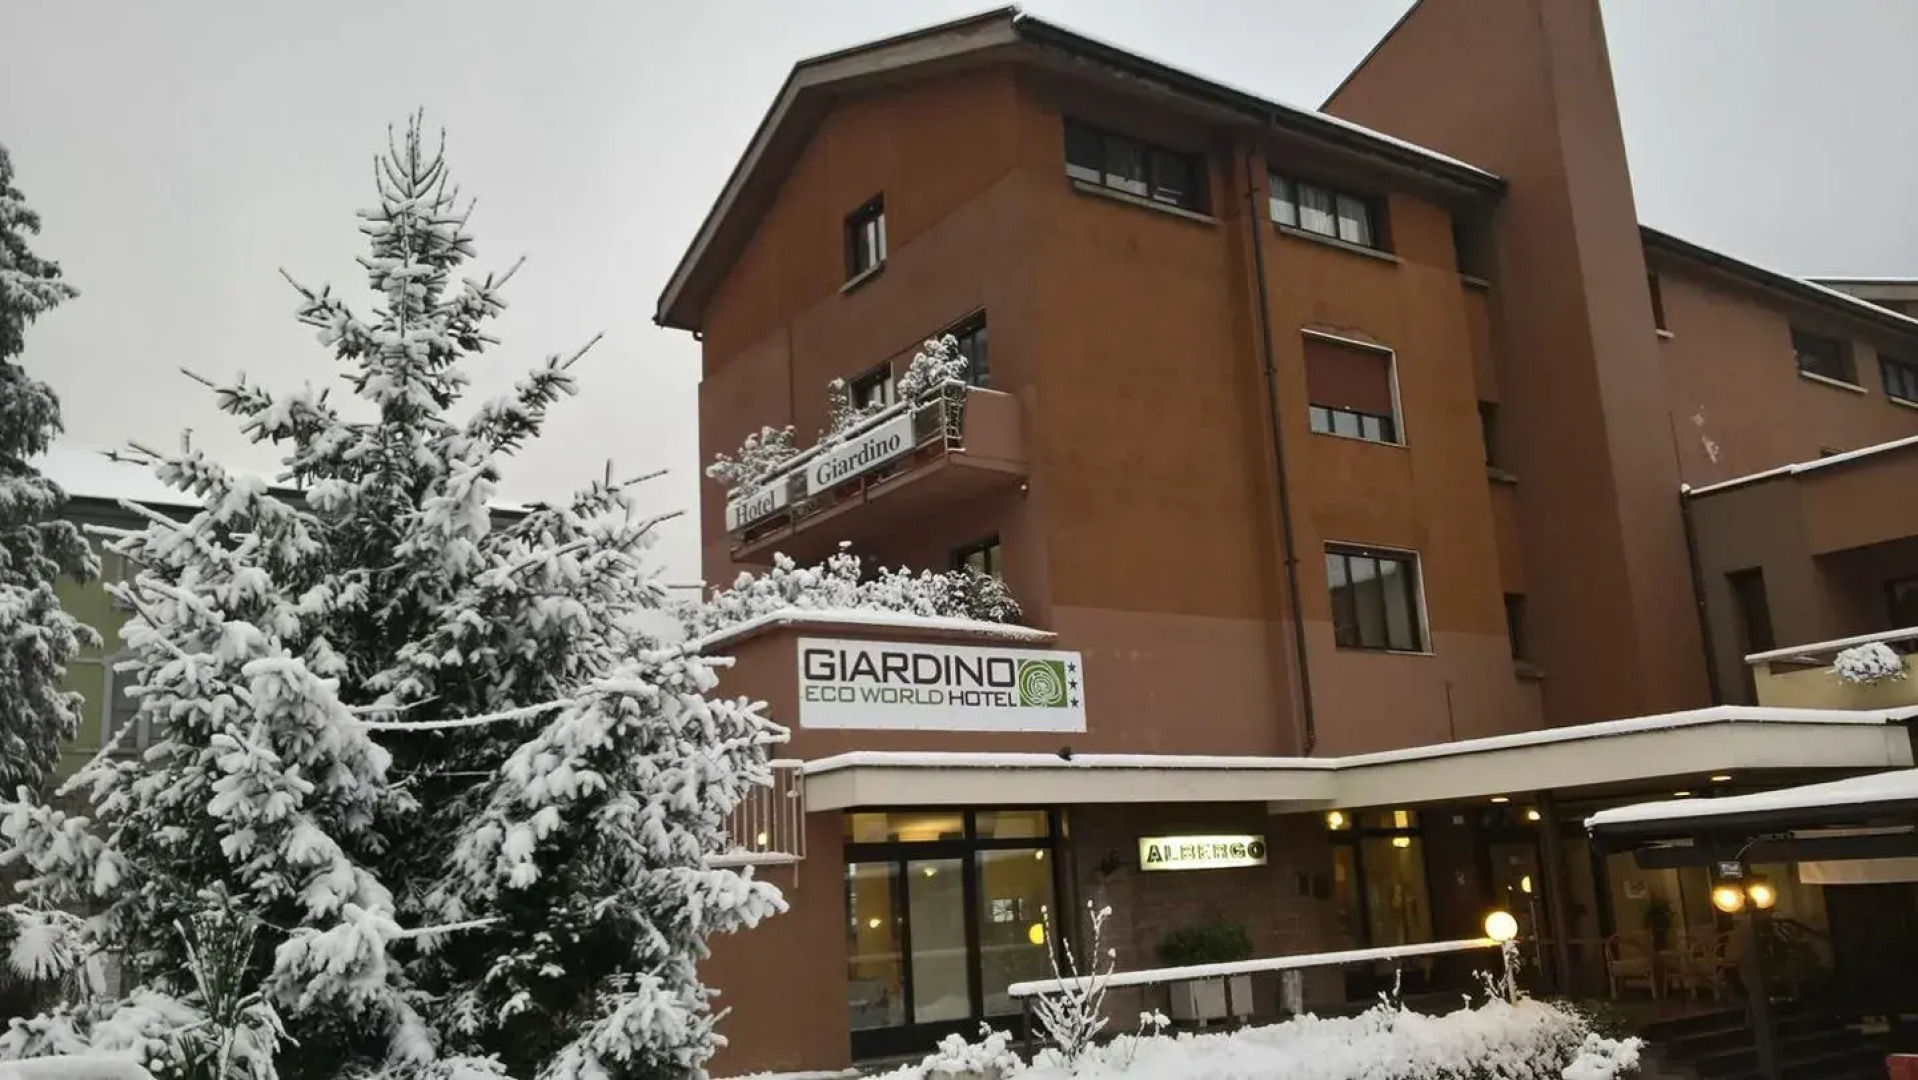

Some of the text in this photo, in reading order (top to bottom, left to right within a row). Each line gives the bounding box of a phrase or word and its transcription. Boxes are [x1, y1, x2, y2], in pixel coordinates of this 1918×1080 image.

[735, 434, 900, 527] Hotel Giardino
[804, 649, 1016, 688] GIARDINO
[805, 685, 1017, 708] ECO WORLD HOTEL
[1147, 841, 1265, 863] ALBERGO
